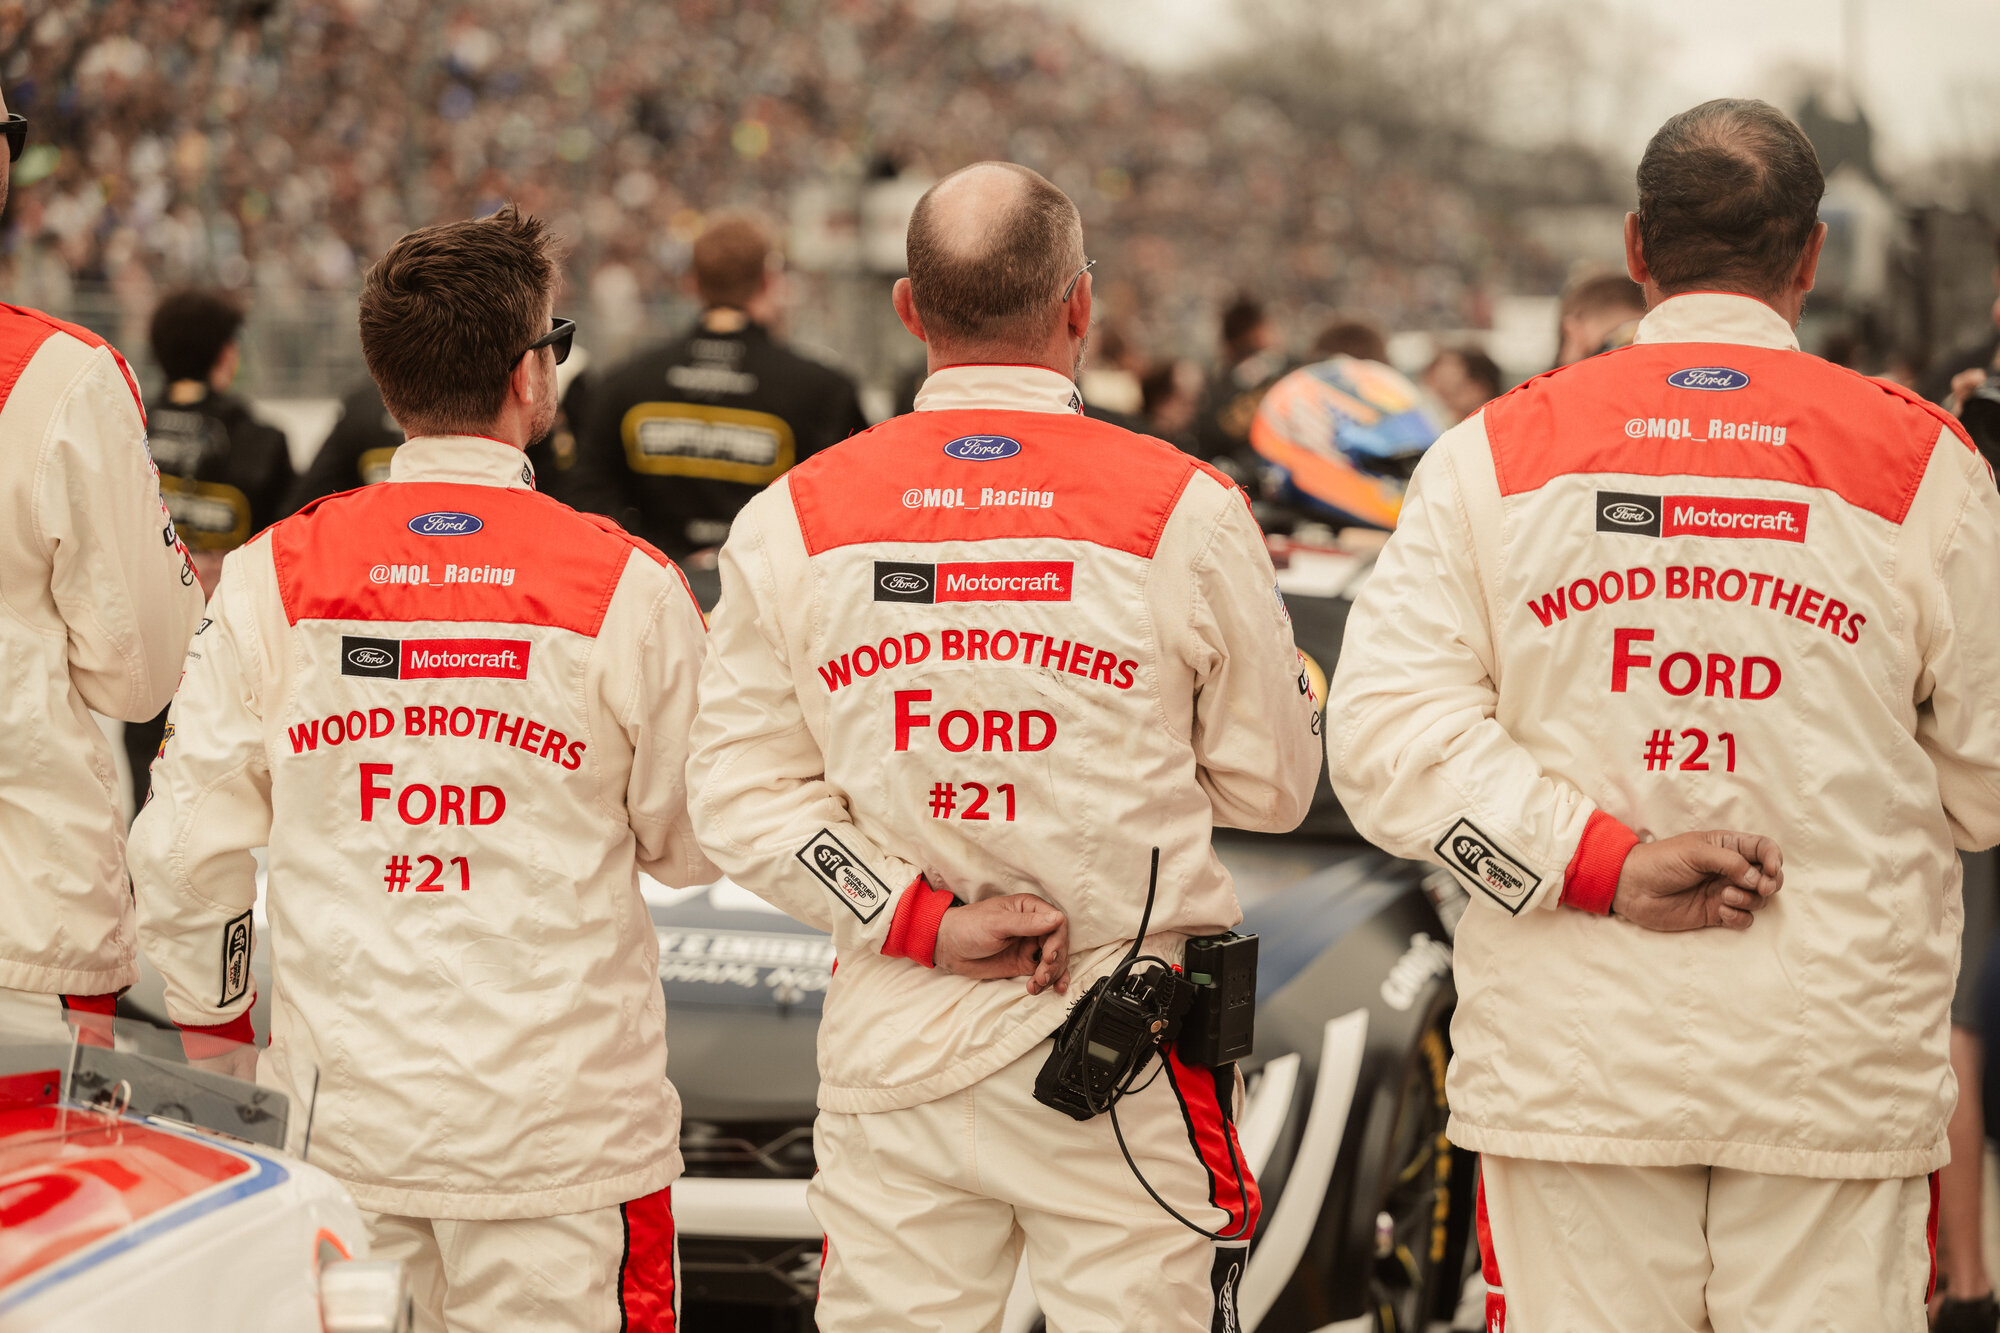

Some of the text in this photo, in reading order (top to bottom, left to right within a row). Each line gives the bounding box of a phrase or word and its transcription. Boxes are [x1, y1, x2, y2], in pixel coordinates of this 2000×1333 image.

[1684, 369, 1732, 387] Ford
[959, 438, 1005, 456] Ford
[1625, 417, 1787, 446] @MQL_Racing
[902, 487, 1054, 510] @MQL_Racing
[423, 514, 468, 532] Ford
[1612, 506, 1795, 532] Ford Motorcraft
[369, 564, 516, 587] @MQL_Racing
[889, 572, 1060, 592] Ford Motorcraft
[1526, 566, 1867, 645] WOOD BROTHERS
[356, 649, 518, 670] Ford Motorcraft
[818, 629, 1139, 693] WOOD BROTHERS
[1610, 627, 1782, 700] FORD
[893, 689, 1057, 753] FORD
[288, 705, 587, 771] WOOD BROTHERS
[1643, 727, 1736, 773] #21
[359, 762, 506, 826] FORD
[928, 781, 1016, 822] #21
[384, 854, 470, 893] #21
[843, 867, 877, 901] MANUFACTURER
[844, 876, 867, 899] CERTIFIED
